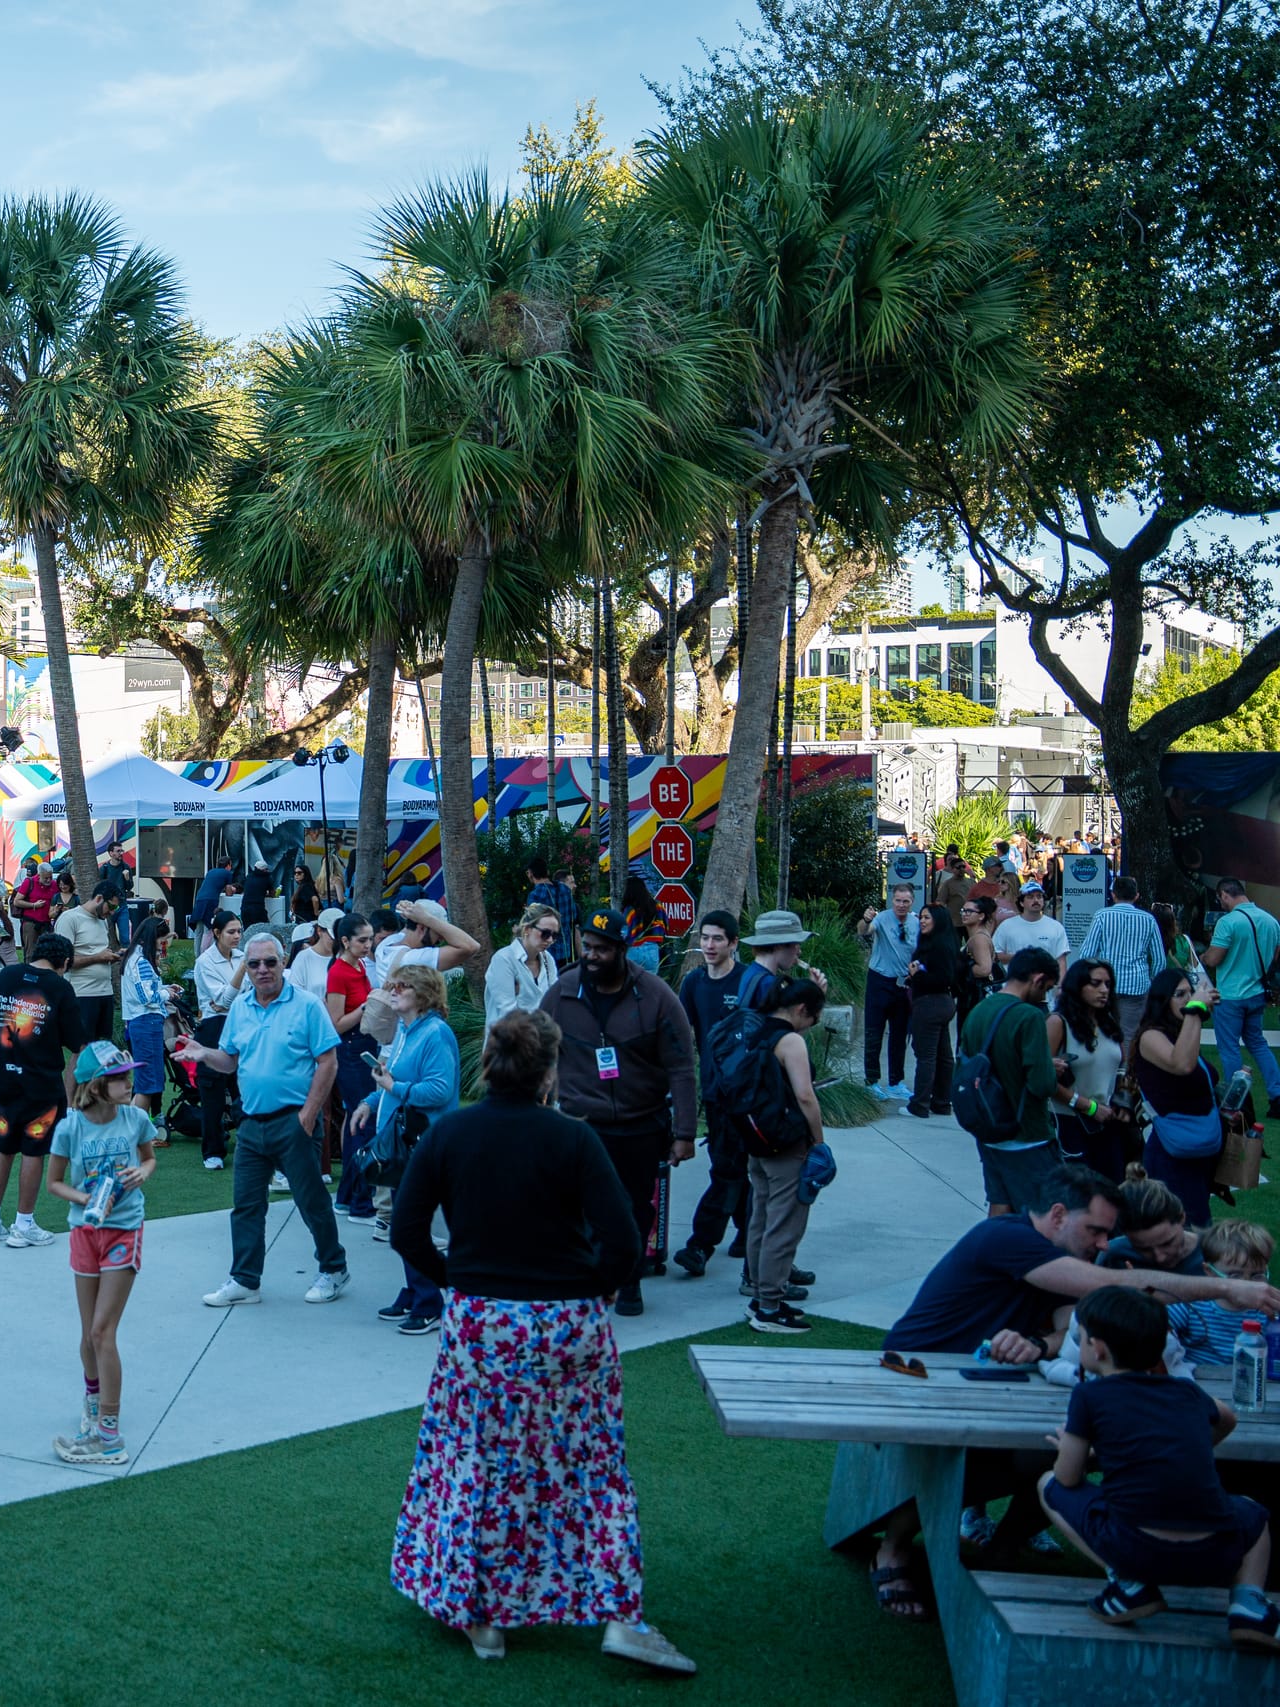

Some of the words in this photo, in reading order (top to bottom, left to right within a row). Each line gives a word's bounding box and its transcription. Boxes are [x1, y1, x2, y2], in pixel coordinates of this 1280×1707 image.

[128, 678, 171, 689] 29wyn.com
[658, 783, 680, 802] BE
[253, 800, 315, 812] BODYARMOR
[658, 842, 686, 862] THE
[1064, 887, 1103, 895] BODYARMOR
[662, 903, 692, 921] HANGE
[82, 1135, 130, 1157] NASA
[657, 1178, 667, 1250] BODYARMOR
